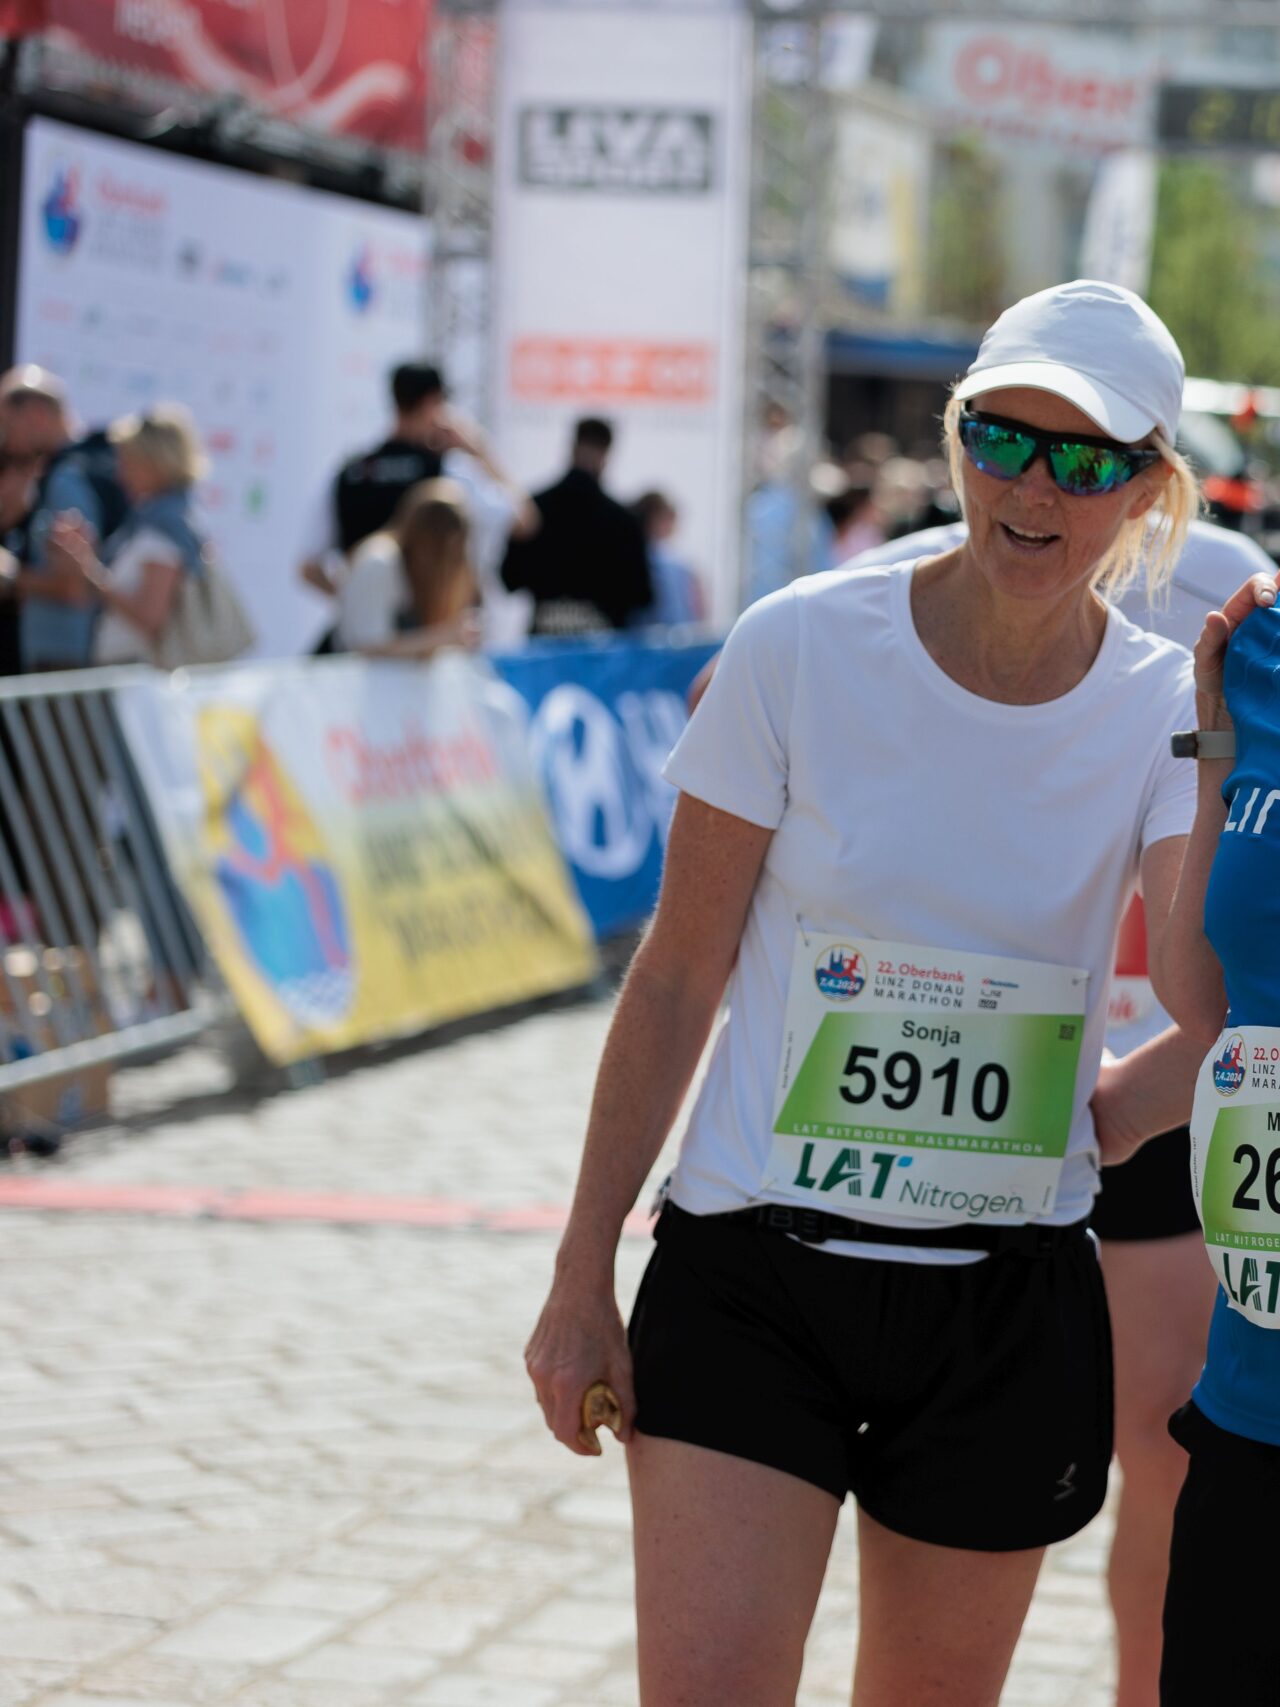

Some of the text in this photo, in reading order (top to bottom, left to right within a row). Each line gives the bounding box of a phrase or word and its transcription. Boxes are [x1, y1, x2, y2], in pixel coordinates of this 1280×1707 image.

[877, 960, 896, 974] 22.
[898, 963, 965, 983] Oberbank
[874, 975, 905, 988] LINZ
[912, 979, 965, 996] DONAU
[873, 988, 962, 1008] MARATHON
[902, 1020, 961, 1047] Sonja
[1253, 1047, 1268, 1061] 22.
[1215, 1070, 1242, 1082] 7.4.2024
[1252, 1064, 1276, 1075] LINZ
[838, 1044, 1011, 1123] 5910
[792, 1123, 1044, 1154] LAT NITROGEN HALBMARATHON
[793, 1142, 900, 1200] LAT
[899, 1179, 1024, 1217] Nitrogen
[1215, 1232, 1230, 1243] LAT
